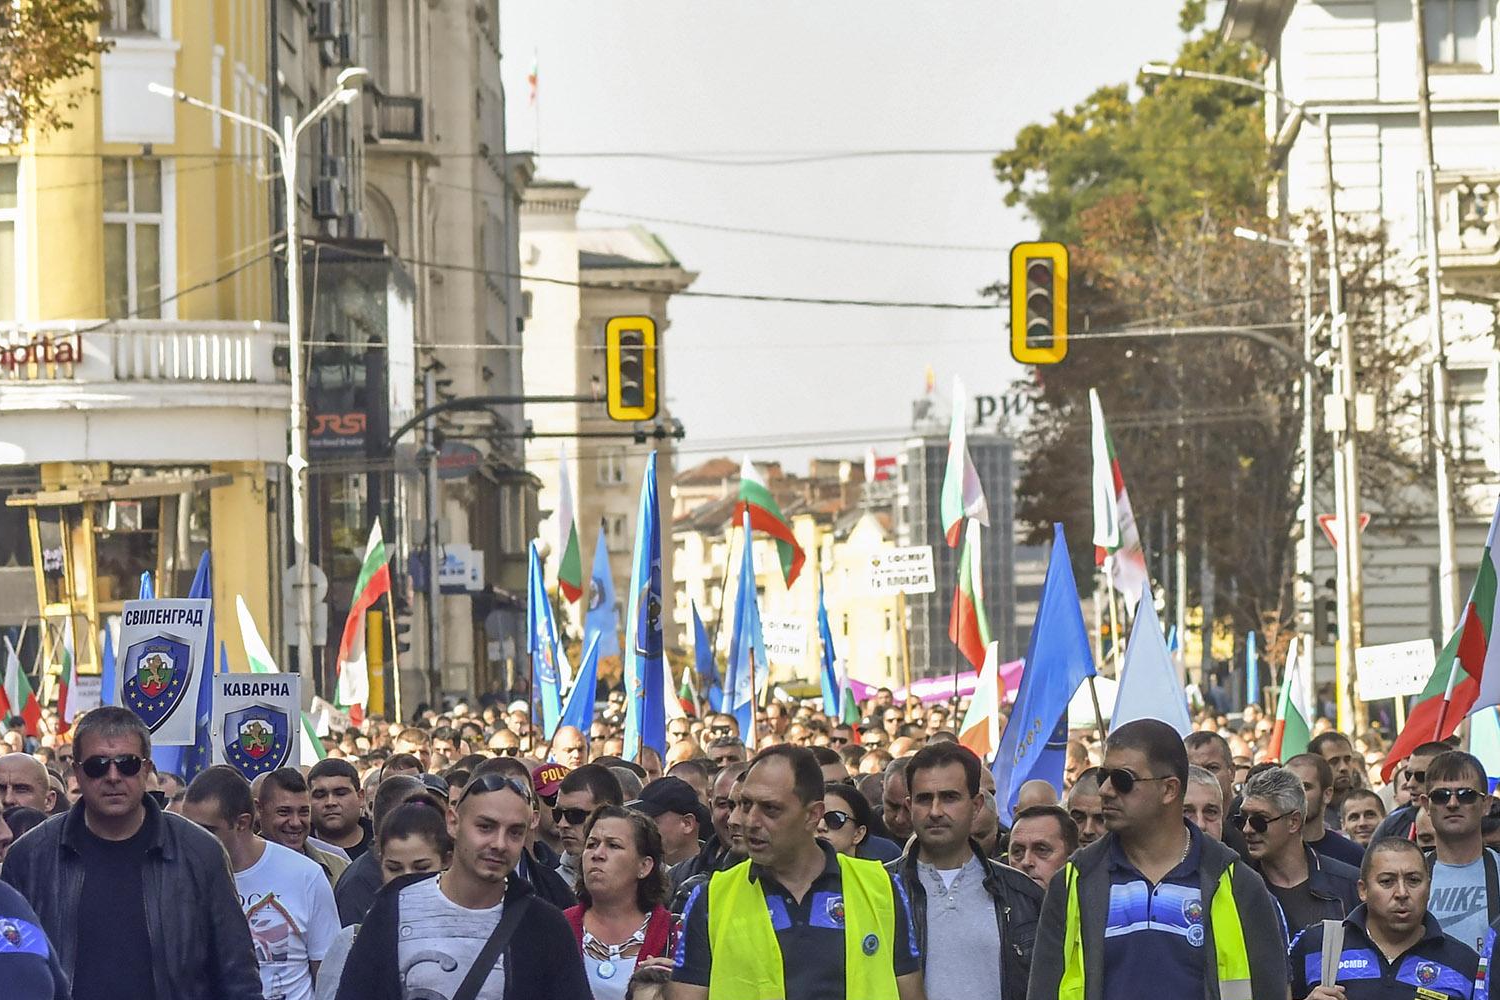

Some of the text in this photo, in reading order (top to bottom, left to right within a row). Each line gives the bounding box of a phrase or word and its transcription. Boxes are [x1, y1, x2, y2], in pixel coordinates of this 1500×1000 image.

[125, 608, 203, 628] СВИЛЕНГРАД
[223, 682, 290, 697] КАВАРНА
[1428, 886, 1486, 912] NIKE
